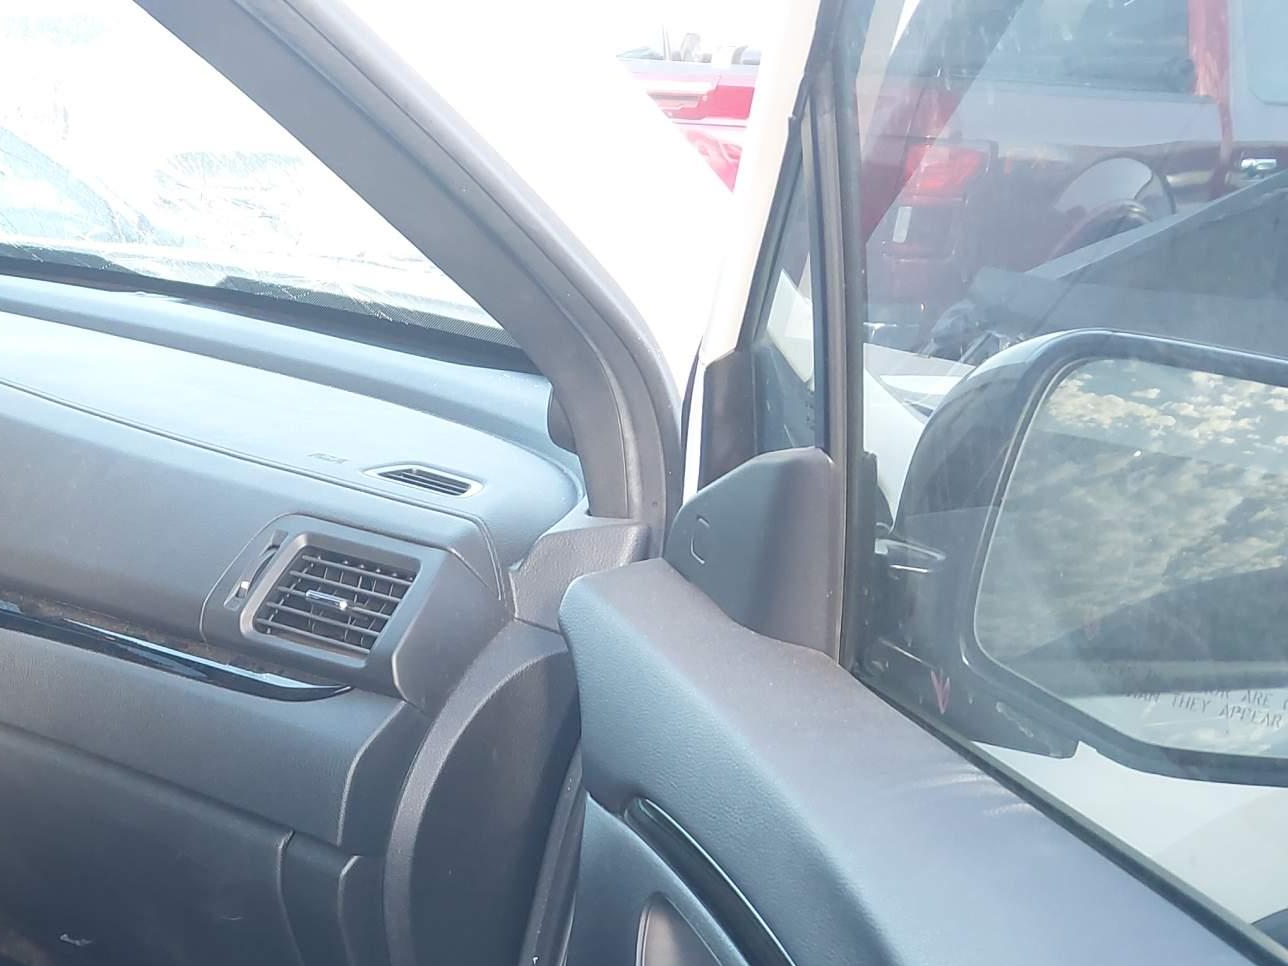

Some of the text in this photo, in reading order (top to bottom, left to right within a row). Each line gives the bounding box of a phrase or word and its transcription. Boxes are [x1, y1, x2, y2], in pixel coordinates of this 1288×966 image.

[1241, 689, 1273, 705] ARE
[1171, 694, 1212, 712] THEY
[1218, 703, 1283, 729] APPEAR
